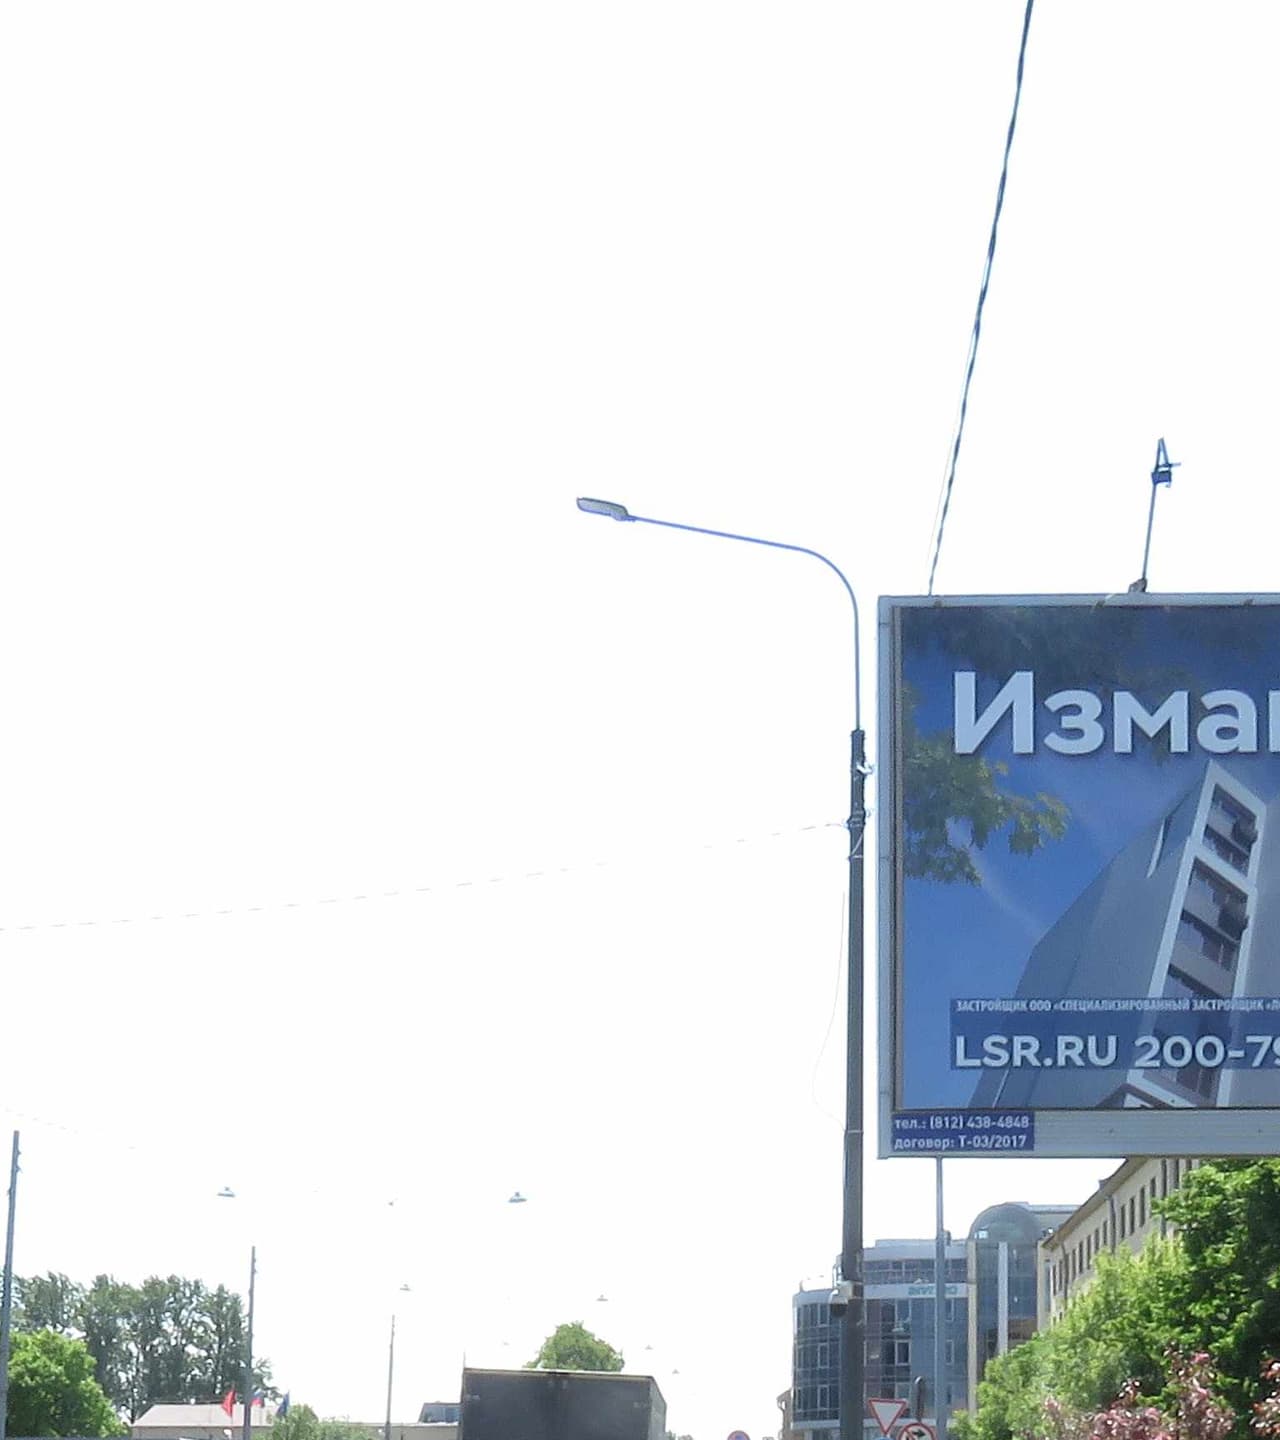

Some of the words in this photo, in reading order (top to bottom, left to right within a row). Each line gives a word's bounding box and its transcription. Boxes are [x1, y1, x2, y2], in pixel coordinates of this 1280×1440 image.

[956, 999, 1028, 1013] ЗАСТРОЙЩИК
[1029, 999, 1052, 1012] ООО
[1191, 999, 1265, 1013] ЗАСТРОЙЩИК
[955, 1034, 1117, 1068] LSR.RU
[929, 1115, 964, 1130] (812)
[966, 1115, 1030, 1129] 438-4848
[893, 1137, 955, 1150] договор:
[957, 1134, 1027, 1149] Т-03/2017
